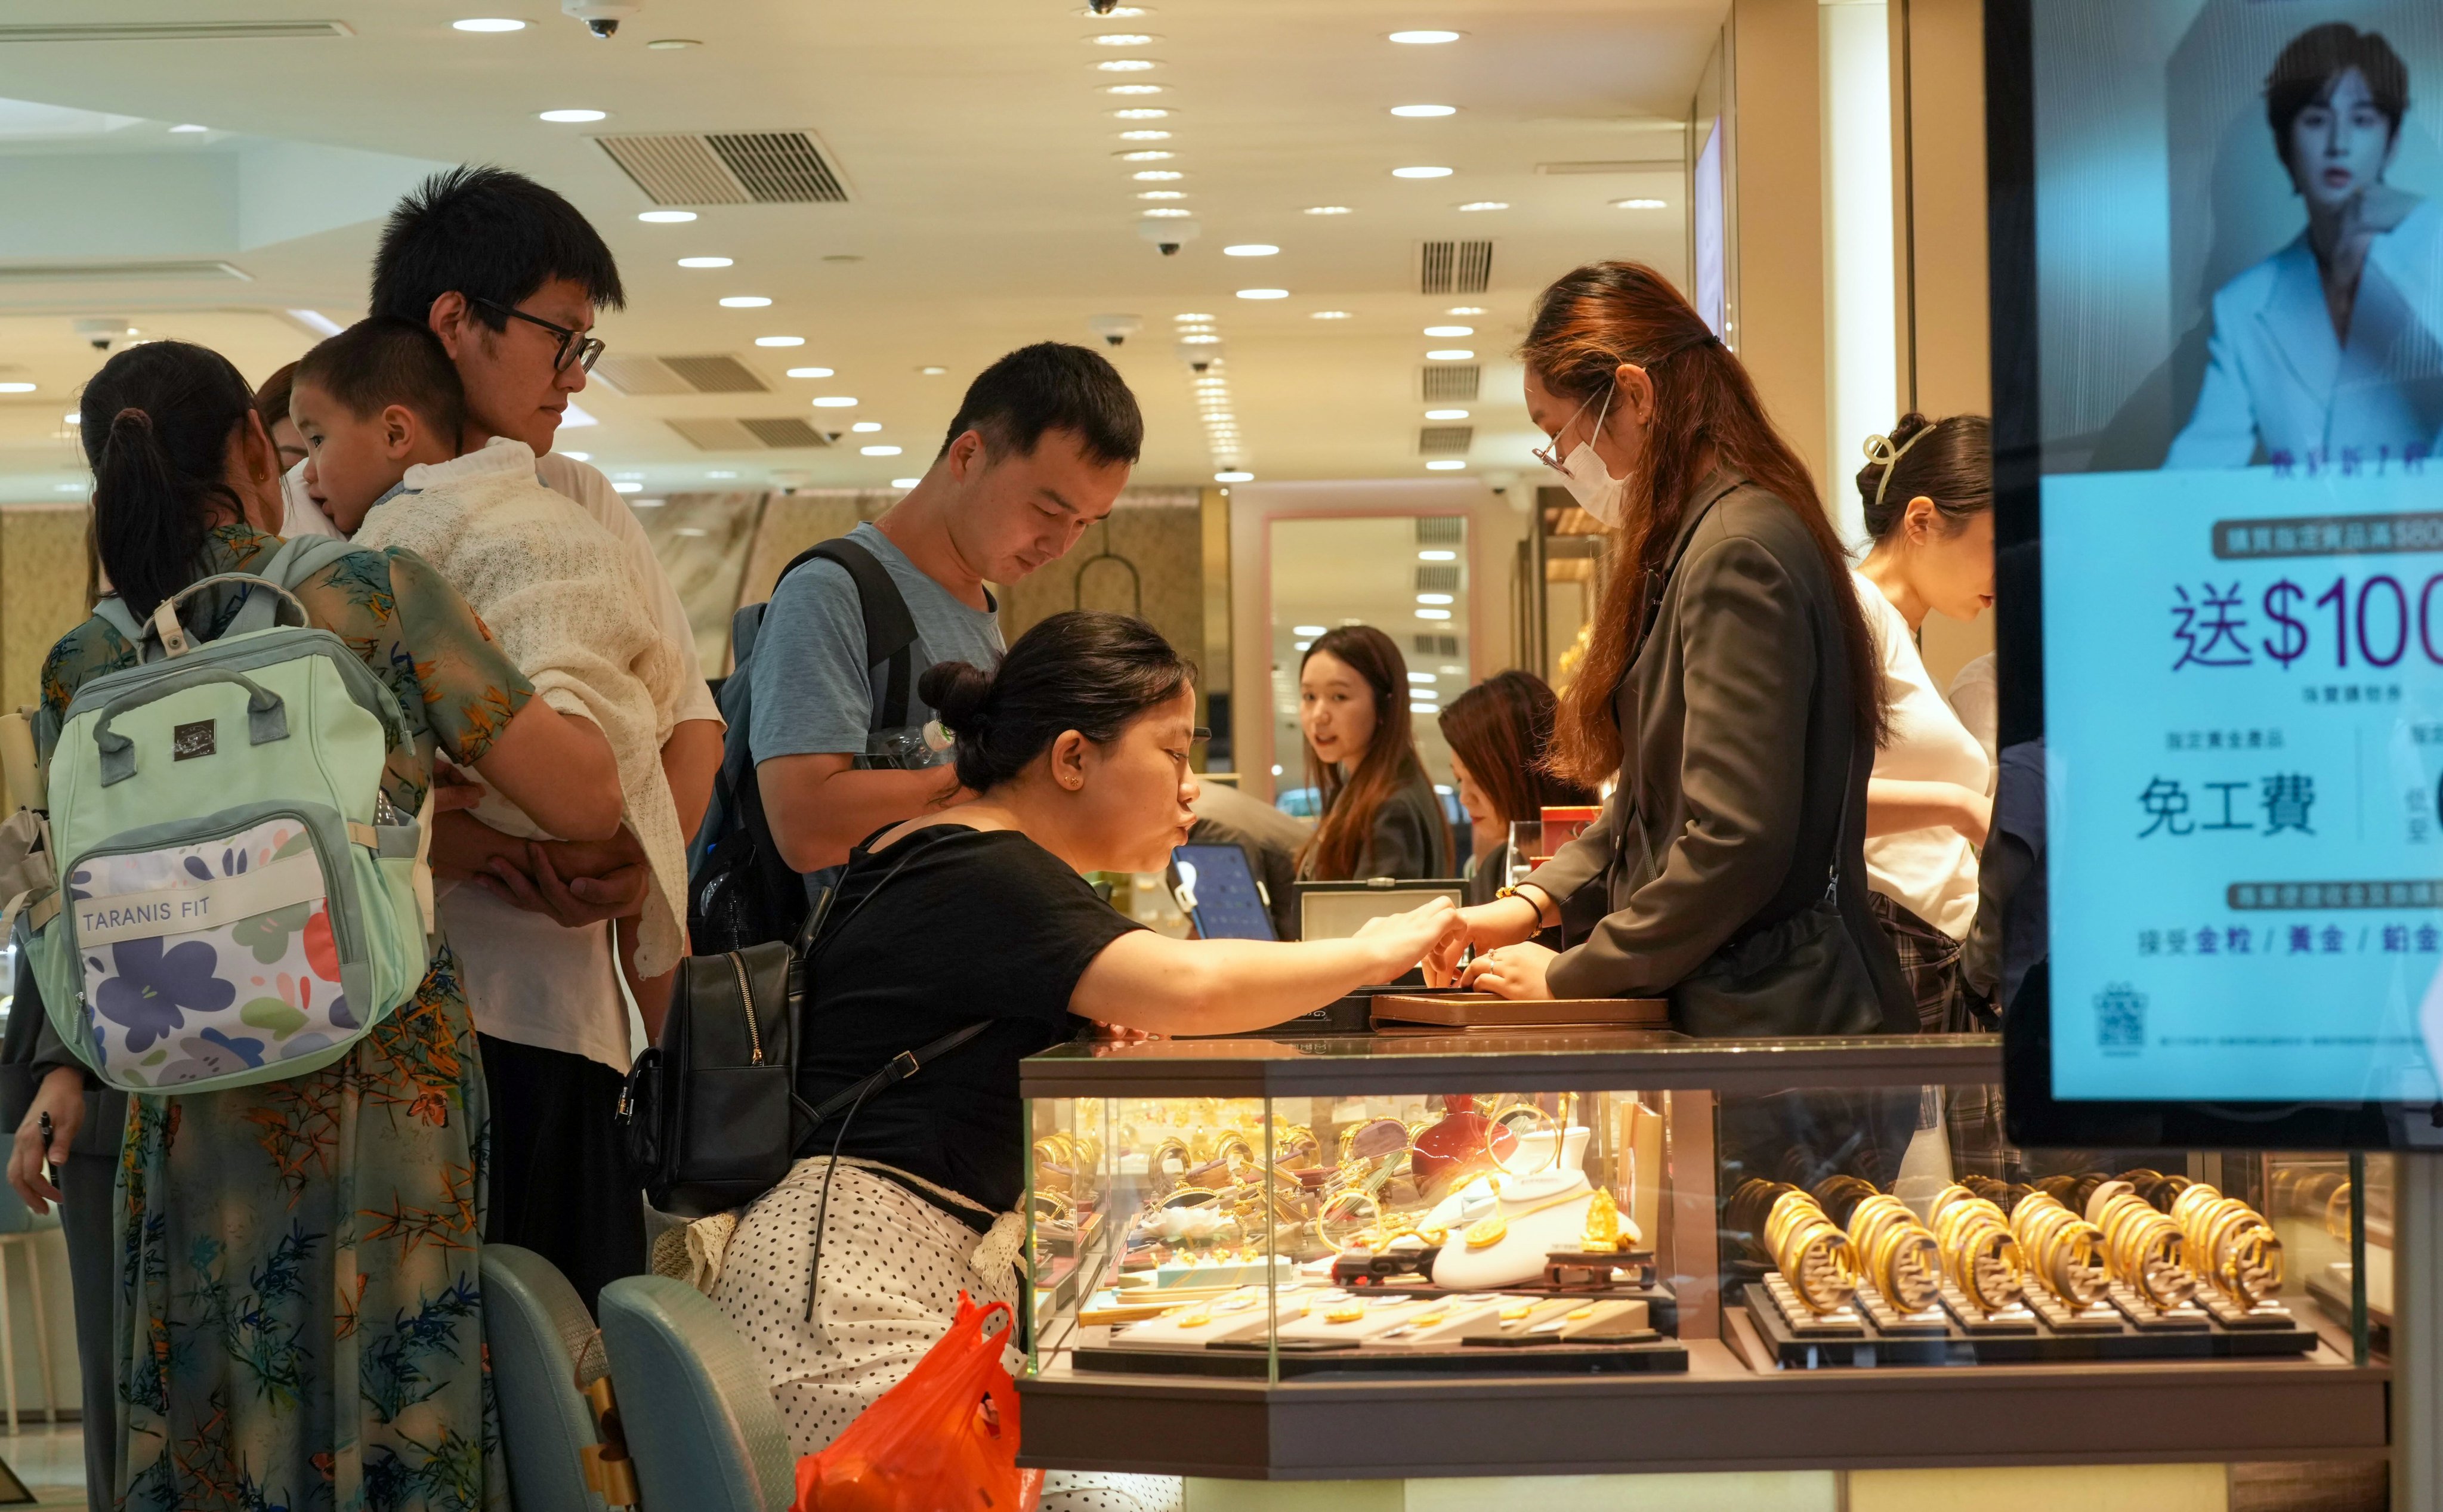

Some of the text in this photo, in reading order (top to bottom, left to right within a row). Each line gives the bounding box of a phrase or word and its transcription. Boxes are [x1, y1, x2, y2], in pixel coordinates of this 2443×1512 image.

[2136, 773, 2318, 838] 免工費
[82, 896, 210, 932] TARANIS FIT
